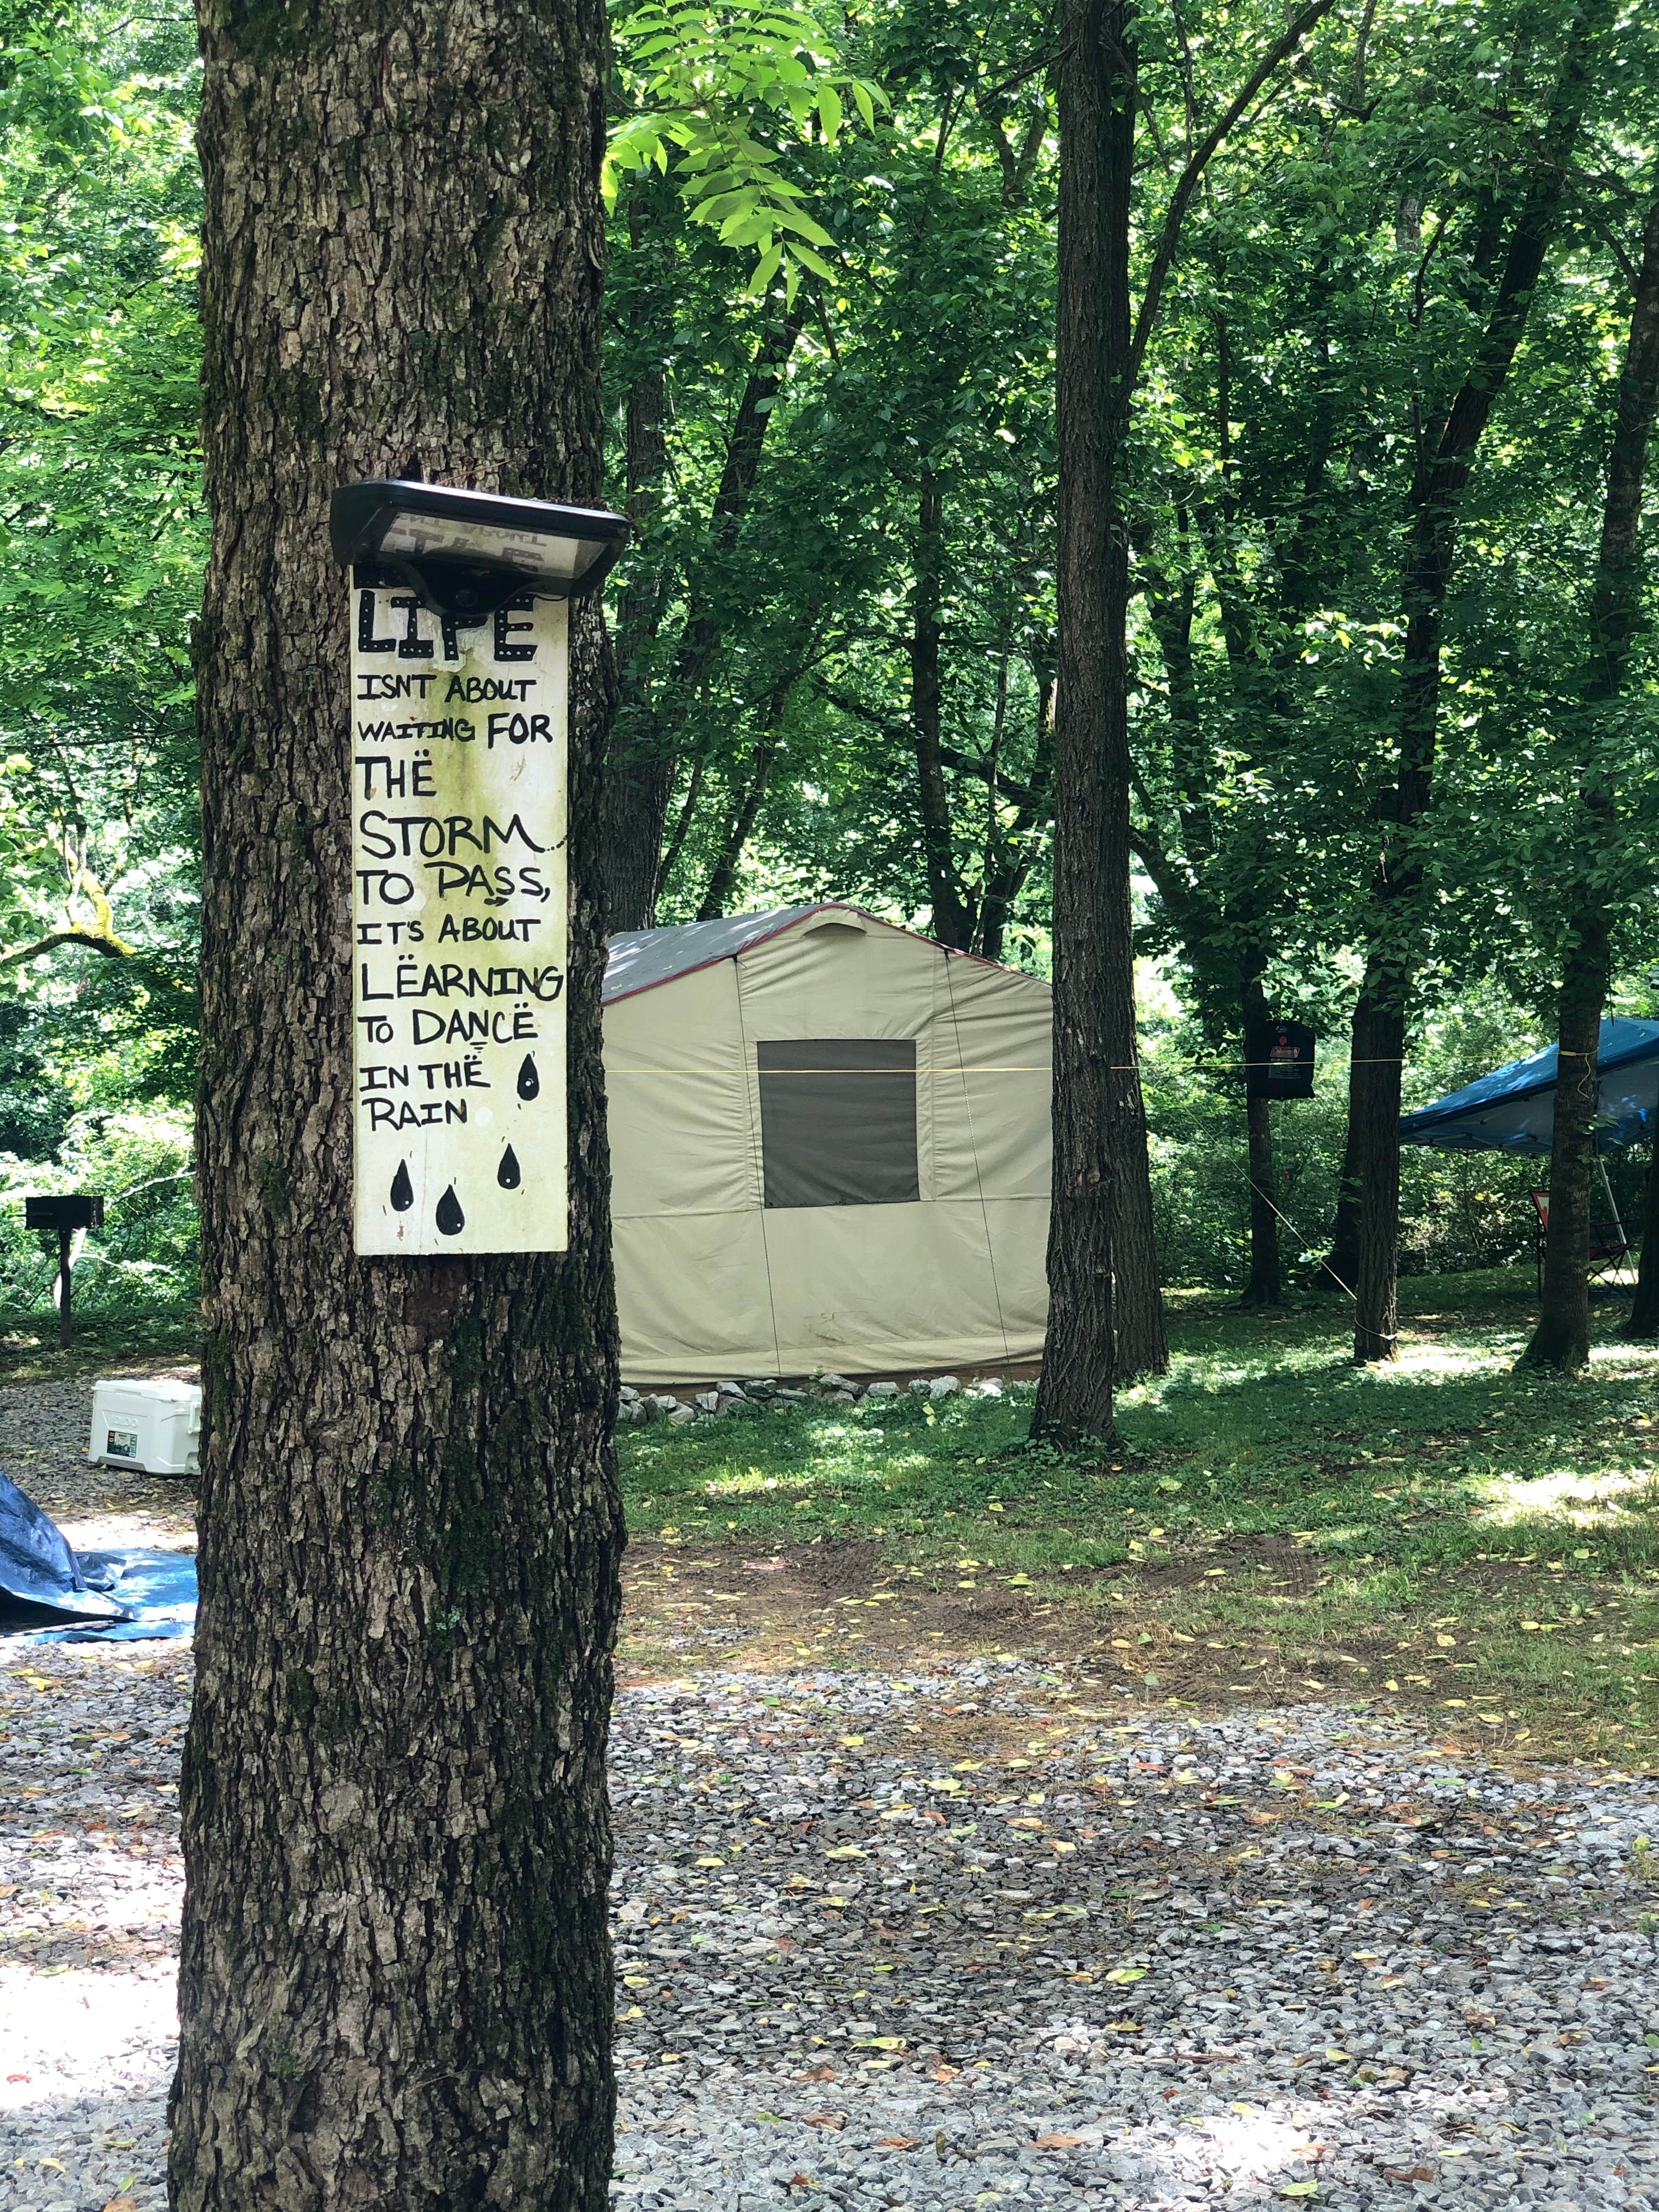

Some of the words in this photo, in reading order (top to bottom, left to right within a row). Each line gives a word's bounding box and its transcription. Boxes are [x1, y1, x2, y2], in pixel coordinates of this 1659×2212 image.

[358, 590, 538, 662] LIFE
[357, 674, 437, 700] ISNT
[444, 675, 537, 703] ABOUT
[358, 717, 476, 742] WAITING
[488, 713, 553, 749] FOR
[360, 810, 546, 859] STORM
[356, 870, 414, 905] TO
[424, 861, 550, 902] PASS,
[357, 920, 425, 945] IT'S
[438, 914, 541, 943] ABOUT
[359, 1064, 409, 1092] IN
[362, 1097, 467, 1131] RAIN
